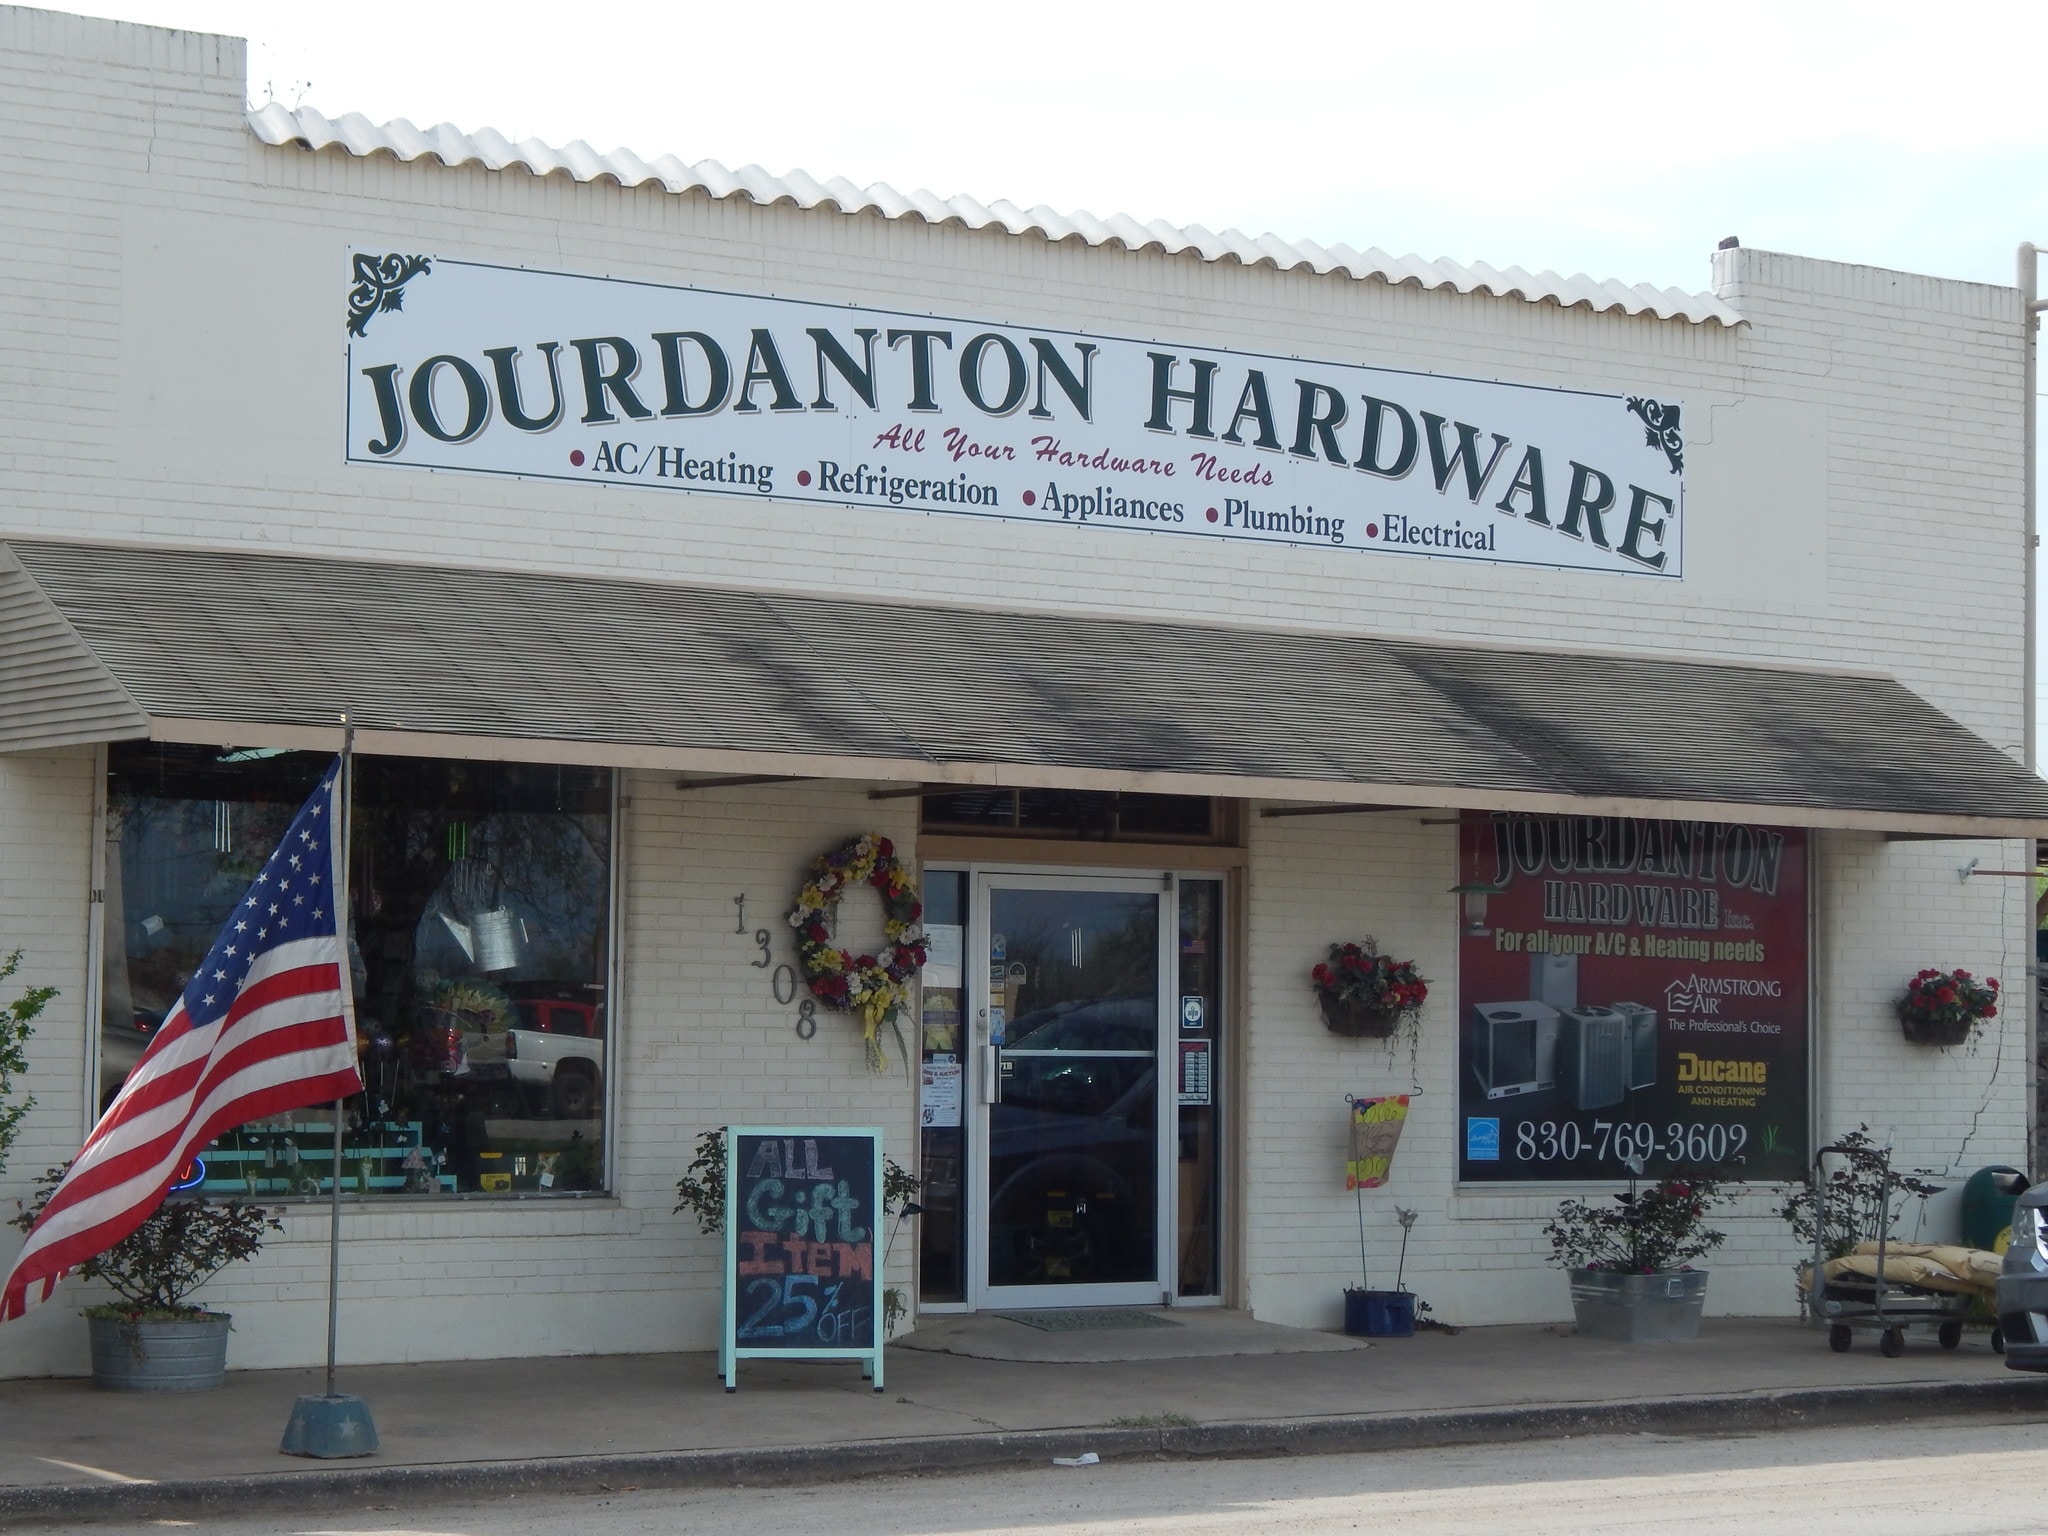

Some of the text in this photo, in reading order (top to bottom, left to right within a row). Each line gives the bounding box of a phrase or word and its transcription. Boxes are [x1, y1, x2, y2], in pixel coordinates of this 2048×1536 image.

[362, 327, 1674, 572] JOURDANTON HARDWARE
[873, 423, 1274, 487] All Your Hardware Needs
[591, 440, 1496, 553] AC/Heating Refrigeration Appliances Plumbing Electrical
[1490, 812, 1784, 896] JOURDANTON
[1543, 880, 1754, 930] HARDWARE Inc.
[1495, 928, 1765, 962] For all your A/C & Heating needs
[1685, 973, 1782, 998] ARMSTRONG
[1667, 1018, 1781, 1034] The Professional's Choice
[1677, 1052, 1767, 1084] Ducane
[1677, 1085, 1767, 1096] AIR CONDITIONING
[1690, 1097, 1756, 1107] AND HEATING
[747, 1138, 834, 1180] ALL
[747, 1178, 867, 1243] Gift
